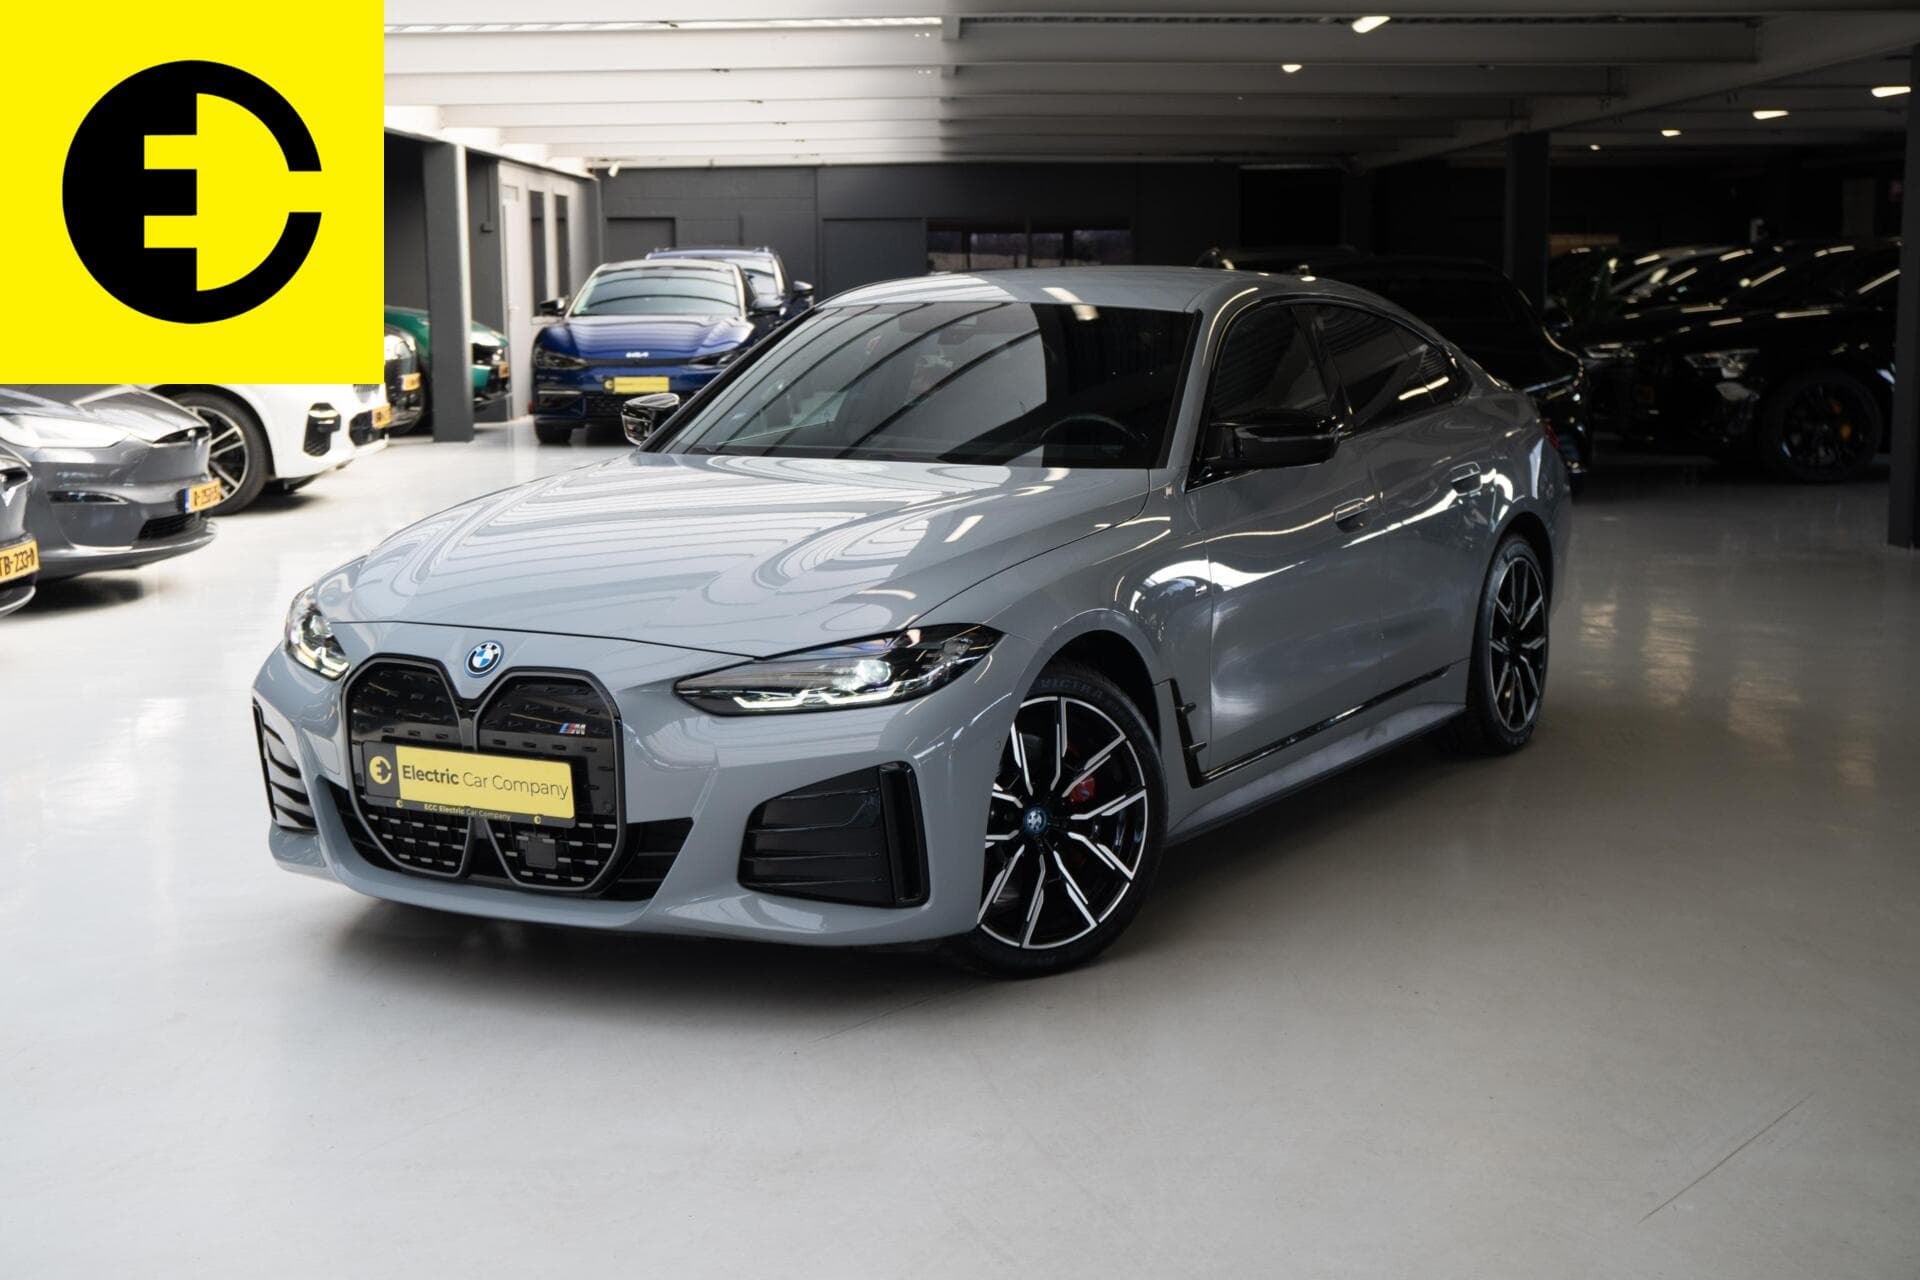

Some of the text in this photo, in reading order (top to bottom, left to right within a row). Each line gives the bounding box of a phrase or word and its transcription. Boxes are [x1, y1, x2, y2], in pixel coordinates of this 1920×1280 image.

[402, 765, 569, 800] Electric Car Company
[423, 803, 512, 821] ECC Electric Car Company
